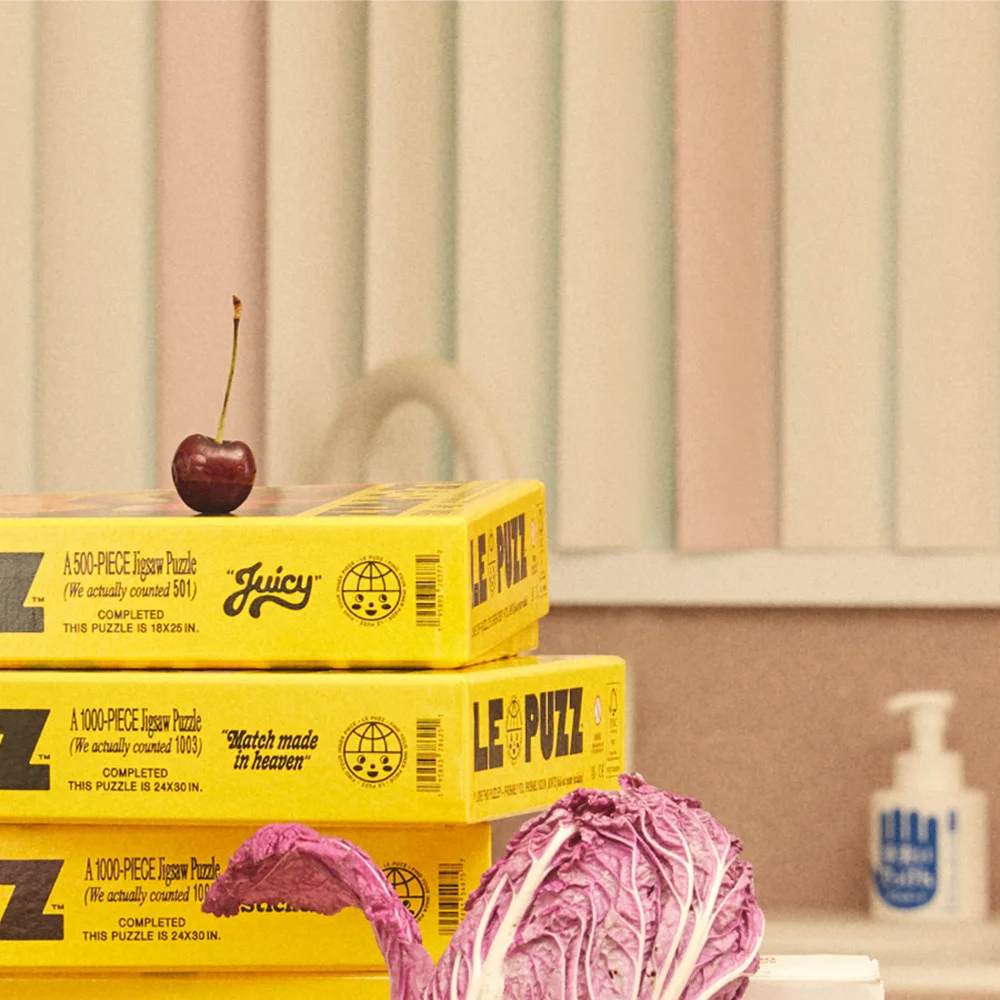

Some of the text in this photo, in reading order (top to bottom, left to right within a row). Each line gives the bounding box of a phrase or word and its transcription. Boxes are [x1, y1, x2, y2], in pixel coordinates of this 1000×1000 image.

[63, 551, 197, 581] A 500-PIECE Jigsaw Puzzle
[470, 533, 488, 609] LE
[496, 512, 527, 594] PUZZ
[87, 581, 197, 602] actually counted 501)
[98, 610, 164, 620] COMPLETED
[64, 624, 133, 633] THIS PUZZLE
[70, 708, 202, 738] A 1000-PIECE Jigsaw Puzzle
[473, 698, 504, 772] LE
[525, 687, 583, 763] PUZZ
[92, 736, 202, 758] actually counted 1003)
[281, 730, 319, 750] made
[233, 751, 249, 770] in
[102, 768, 168, 778] COMPLETED
[68, 781, 138, 791] THIS PUZZLE
[85, 857, 221, 886] A 1000-PIECE Jigsaw Puzzle
[107, 887, 190, 906] actually counted
[119, 917, 186, 928] COMPLETED
[83, 930, 154, 941] THIS PUZZLE
